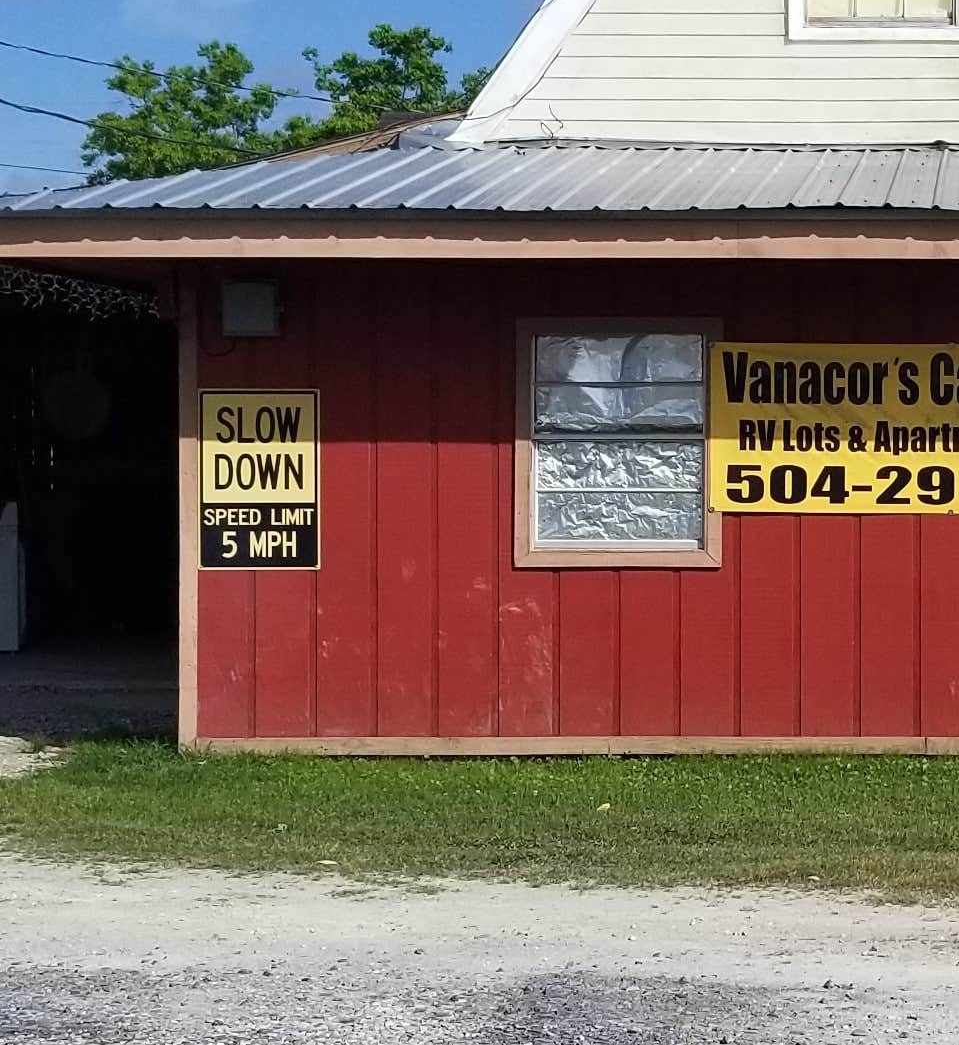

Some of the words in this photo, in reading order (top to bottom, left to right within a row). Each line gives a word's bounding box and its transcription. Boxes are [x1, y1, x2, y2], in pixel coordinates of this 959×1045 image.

[722, 351, 919, 406] Vanacor's
[216, 406, 301, 443] SLOW
[739, 419, 776, 452] RV
[783, 419, 840, 453] Lots
[848, 425, 868, 453] &
[214, 453, 304, 491] DOWN
[203, 508, 262, 526] SPEED
[271, 508, 315, 526] LIMIT
[221, 531, 238, 559] 5
[249, 531, 297, 559] MPH
